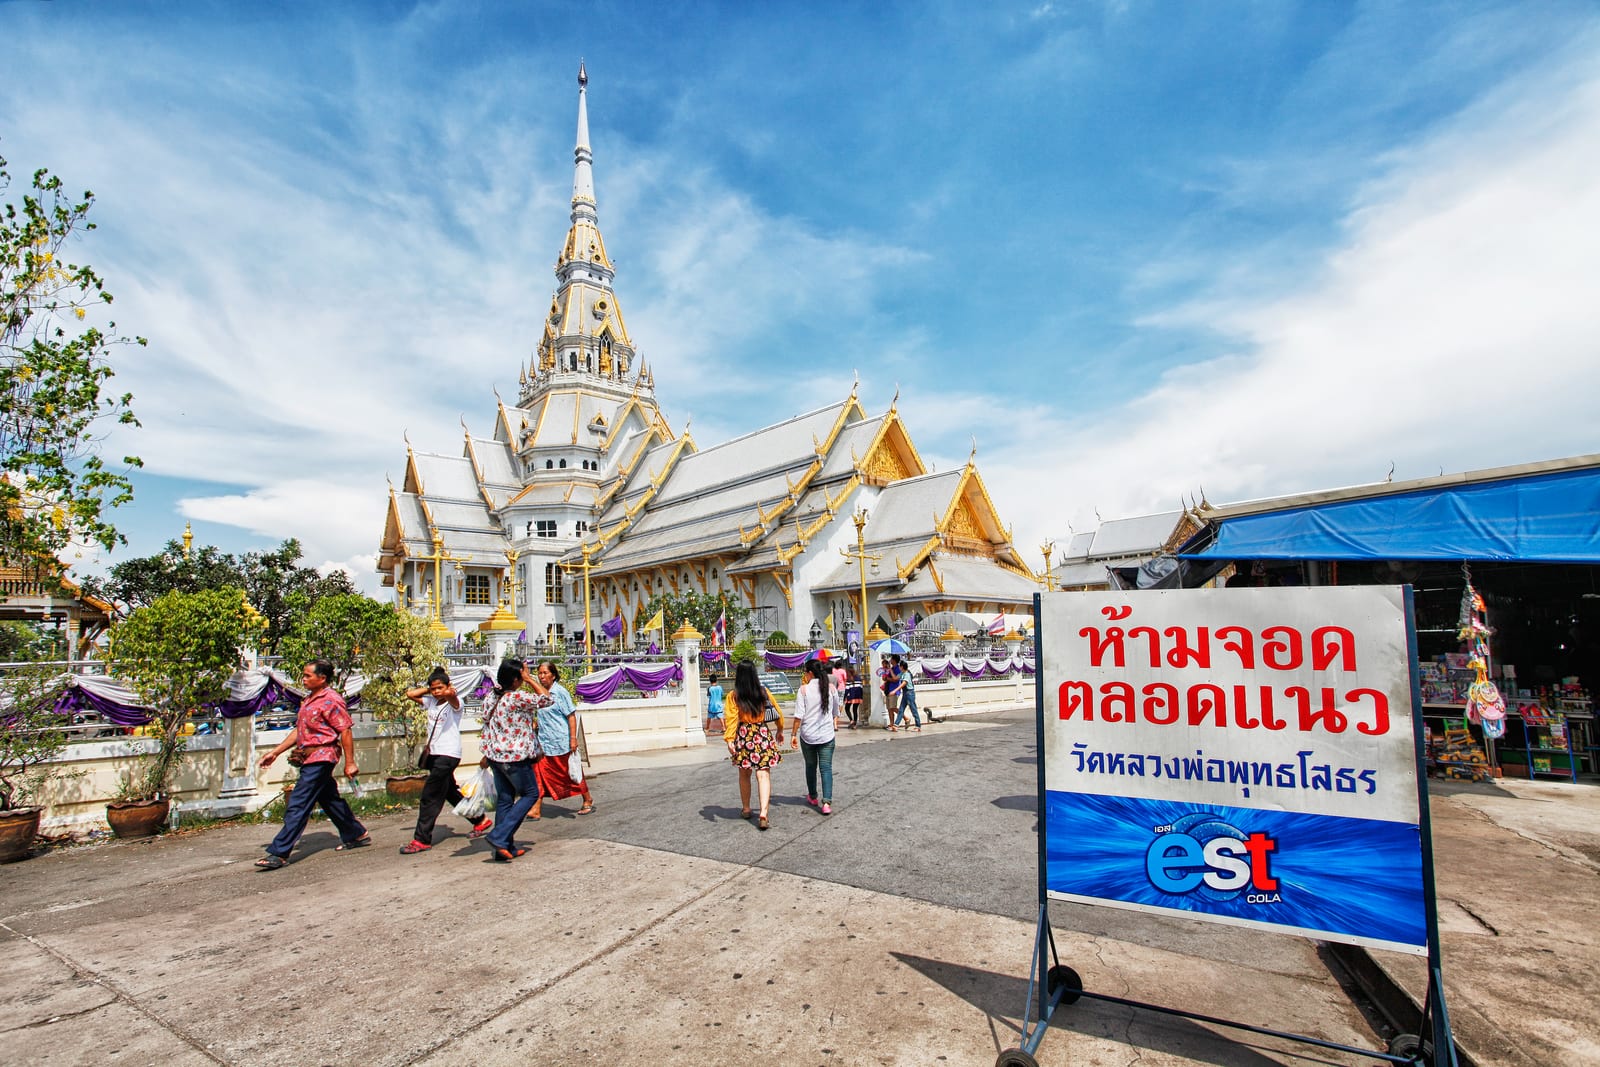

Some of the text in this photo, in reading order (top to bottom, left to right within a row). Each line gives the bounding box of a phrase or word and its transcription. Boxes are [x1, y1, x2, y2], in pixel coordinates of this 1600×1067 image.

[1079, 605, 1357, 672] ห้ามจอด
[1058, 680, 1390, 736] ตลอดแนว
[1070, 742, 1377, 798] วัดหลวงพ่อพุทธโสธร
[1147, 833, 1277, 893] est
[1246, 893, 1281, 904] COLA
